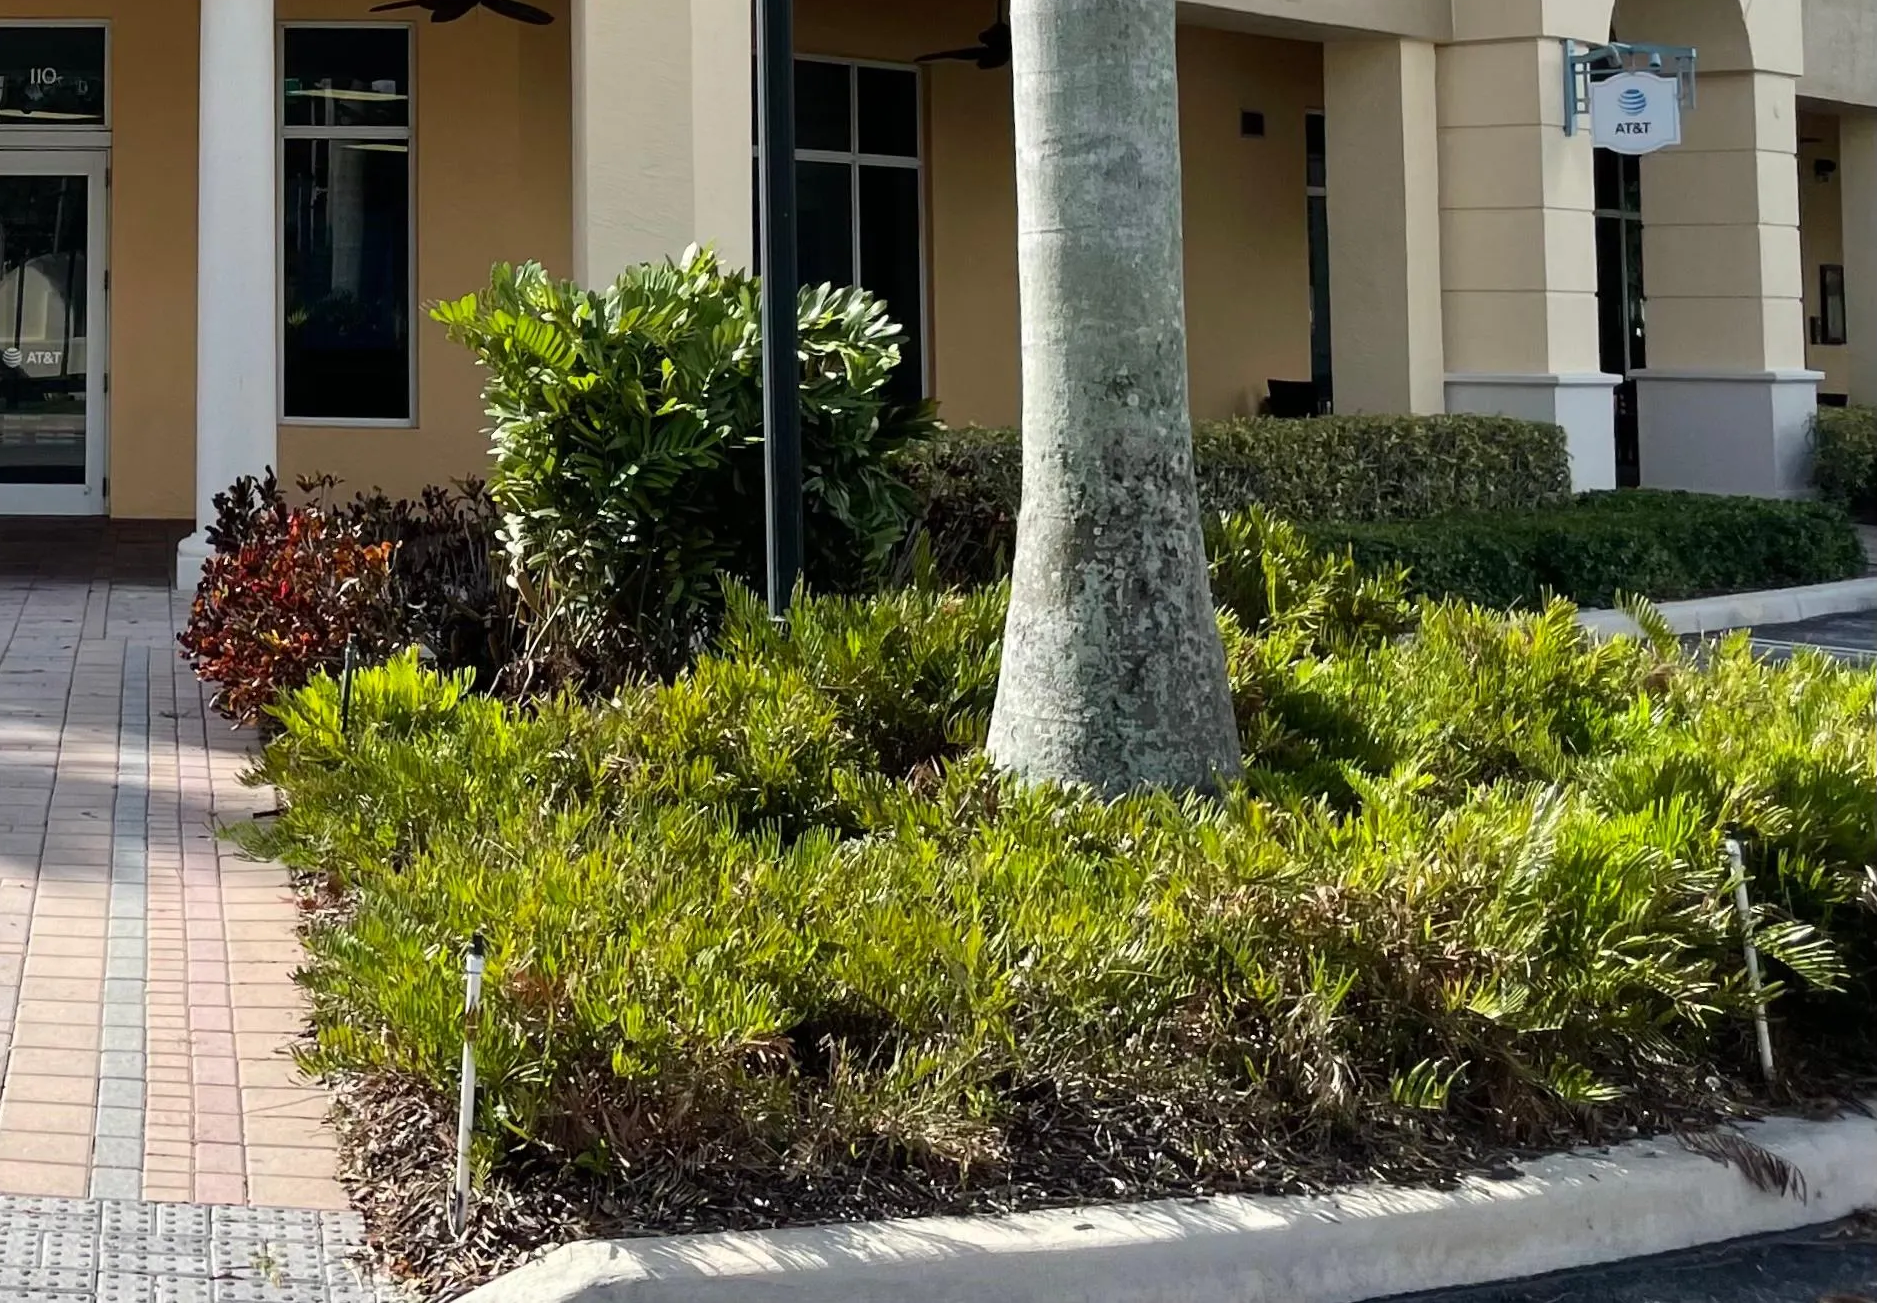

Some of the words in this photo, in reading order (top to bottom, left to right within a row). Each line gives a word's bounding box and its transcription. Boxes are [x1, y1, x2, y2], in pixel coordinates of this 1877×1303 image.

[30, 68, 57, 84] 110
[1615, 121, 1651, 134] AT&T
[26, 350, 62, 364] AT&T
